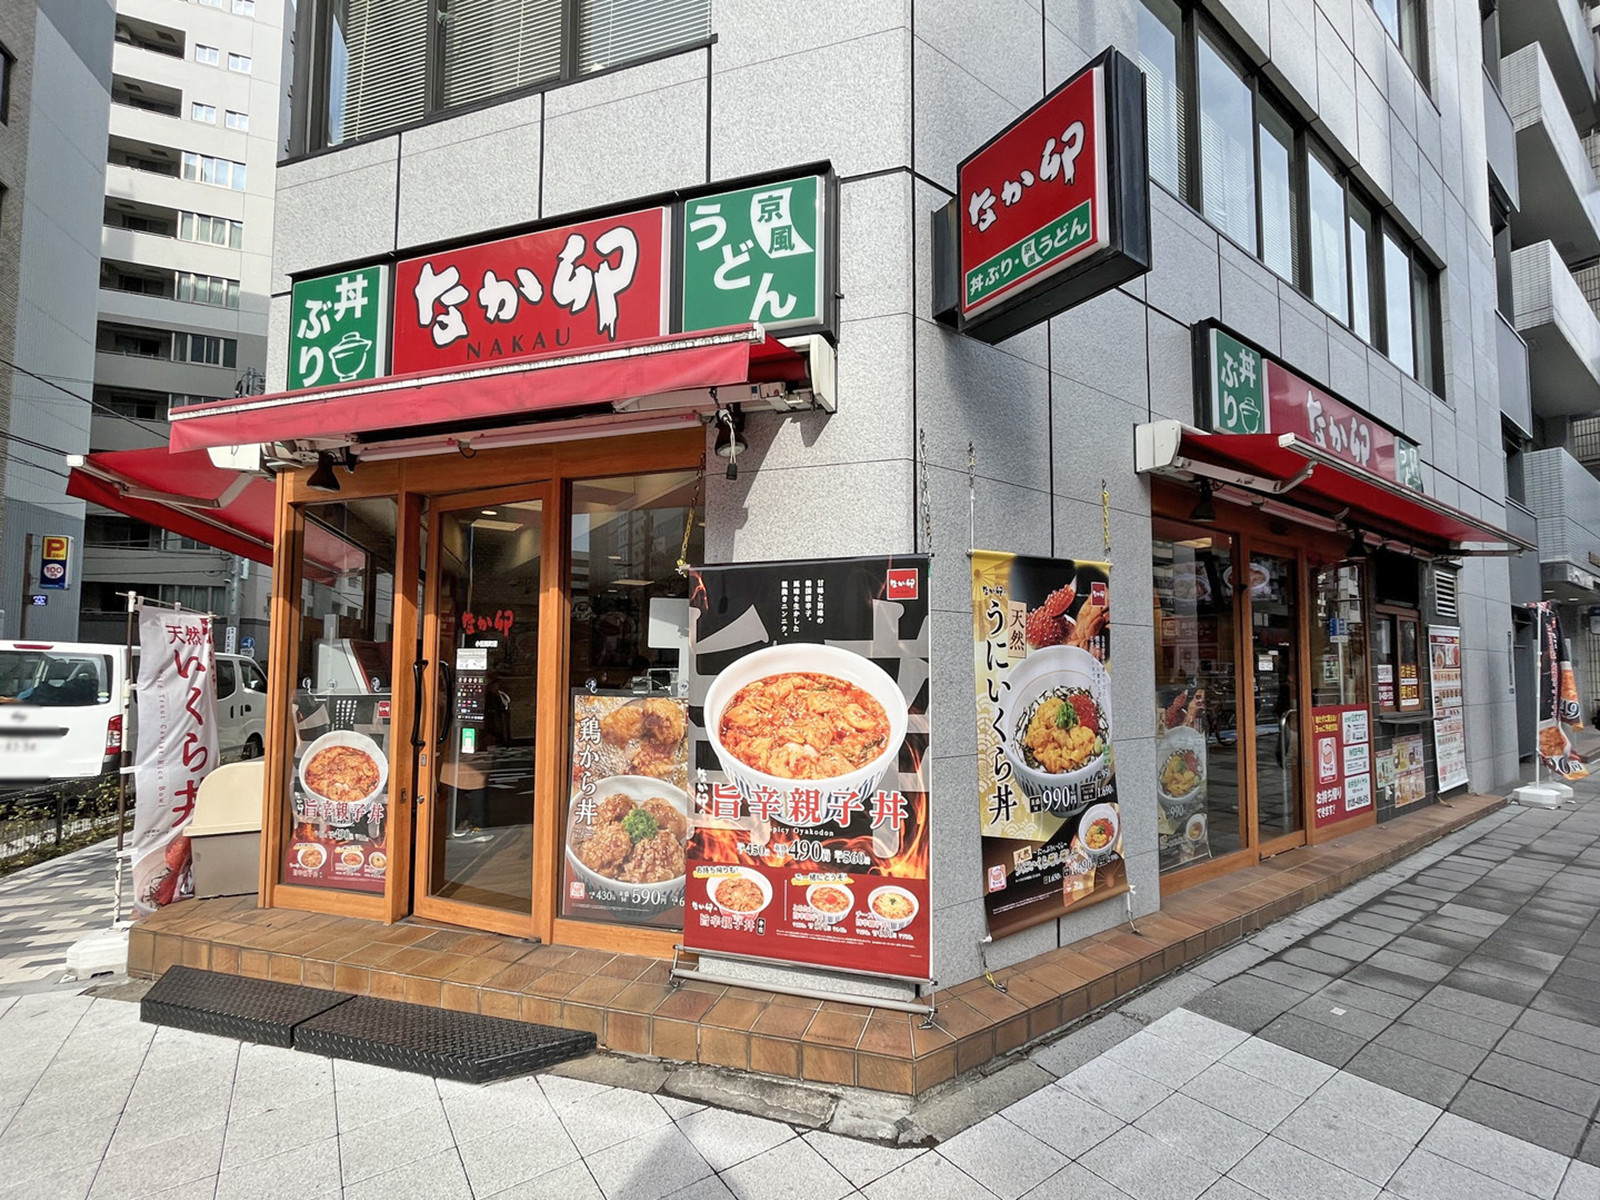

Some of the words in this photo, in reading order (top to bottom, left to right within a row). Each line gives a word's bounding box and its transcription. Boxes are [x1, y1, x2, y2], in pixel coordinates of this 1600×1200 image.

[968, 120, 1085, 233] なか卯
[757, 195, 795, 254] 京風
[689, 203, 797, 321] うどん
[414, 226, 639, 348] なか卯
[466, 327, 573, 361] NAKAU
[47, 538, 65, 558] P
[165, 624, 202, 646] 天然
[462, 610, 514, 638] なか卯
[1009, 609, 1025, 651] 天然
[985, 600, 1018, 825] うにいくら丼
[575, 716, 601, 826] 鶏から丼
[304, 798, 385, 824] 旨辛親子丼
[712, 782, 909, 830] 旨辛親子丼
[793, 827, 835, 837] Oyakodon
